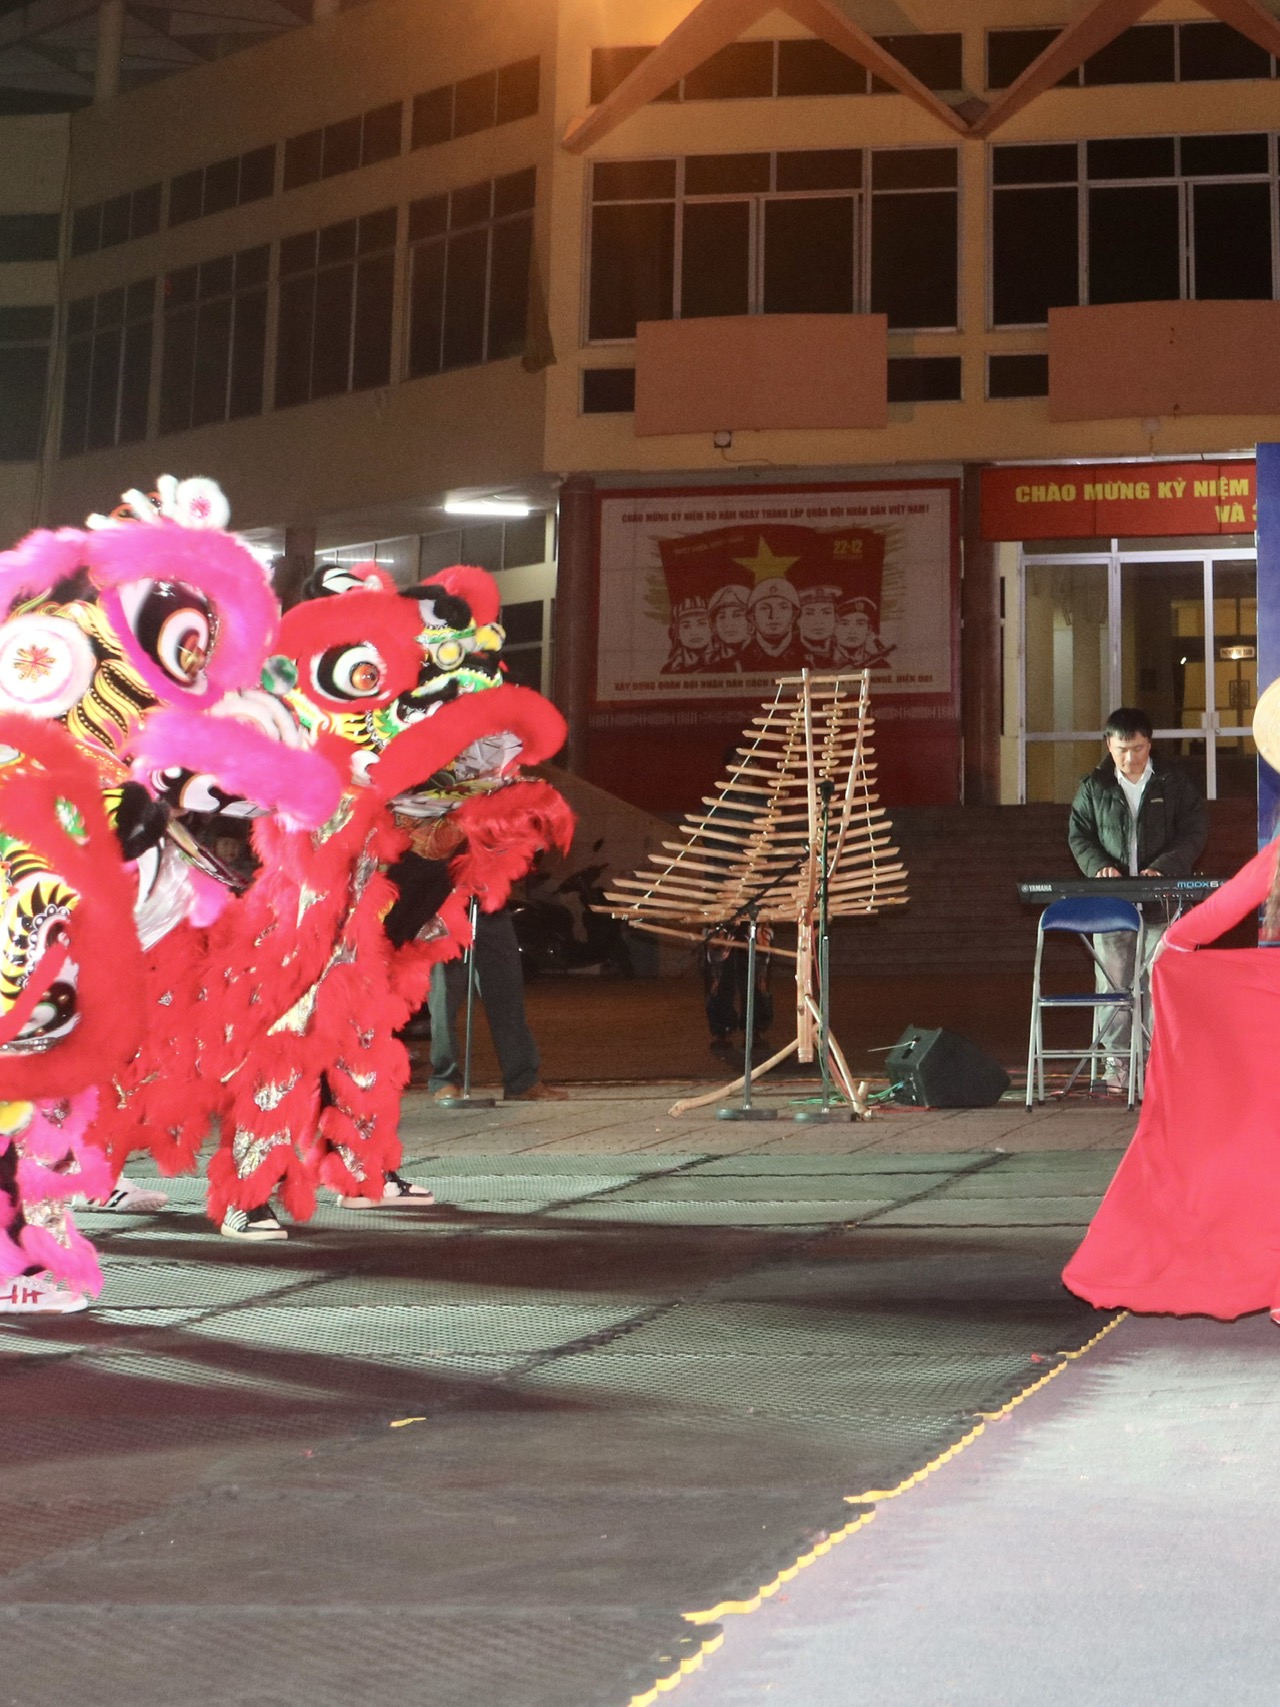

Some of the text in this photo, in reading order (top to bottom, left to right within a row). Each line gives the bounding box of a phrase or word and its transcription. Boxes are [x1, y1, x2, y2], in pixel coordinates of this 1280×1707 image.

[1015, 476, 1249, 503] CHÀO MỪNG KỶ NIỆM
[1214, 501, 1246, 523] VÀ
[1029, 884, 1052, 892] YAMAHA
